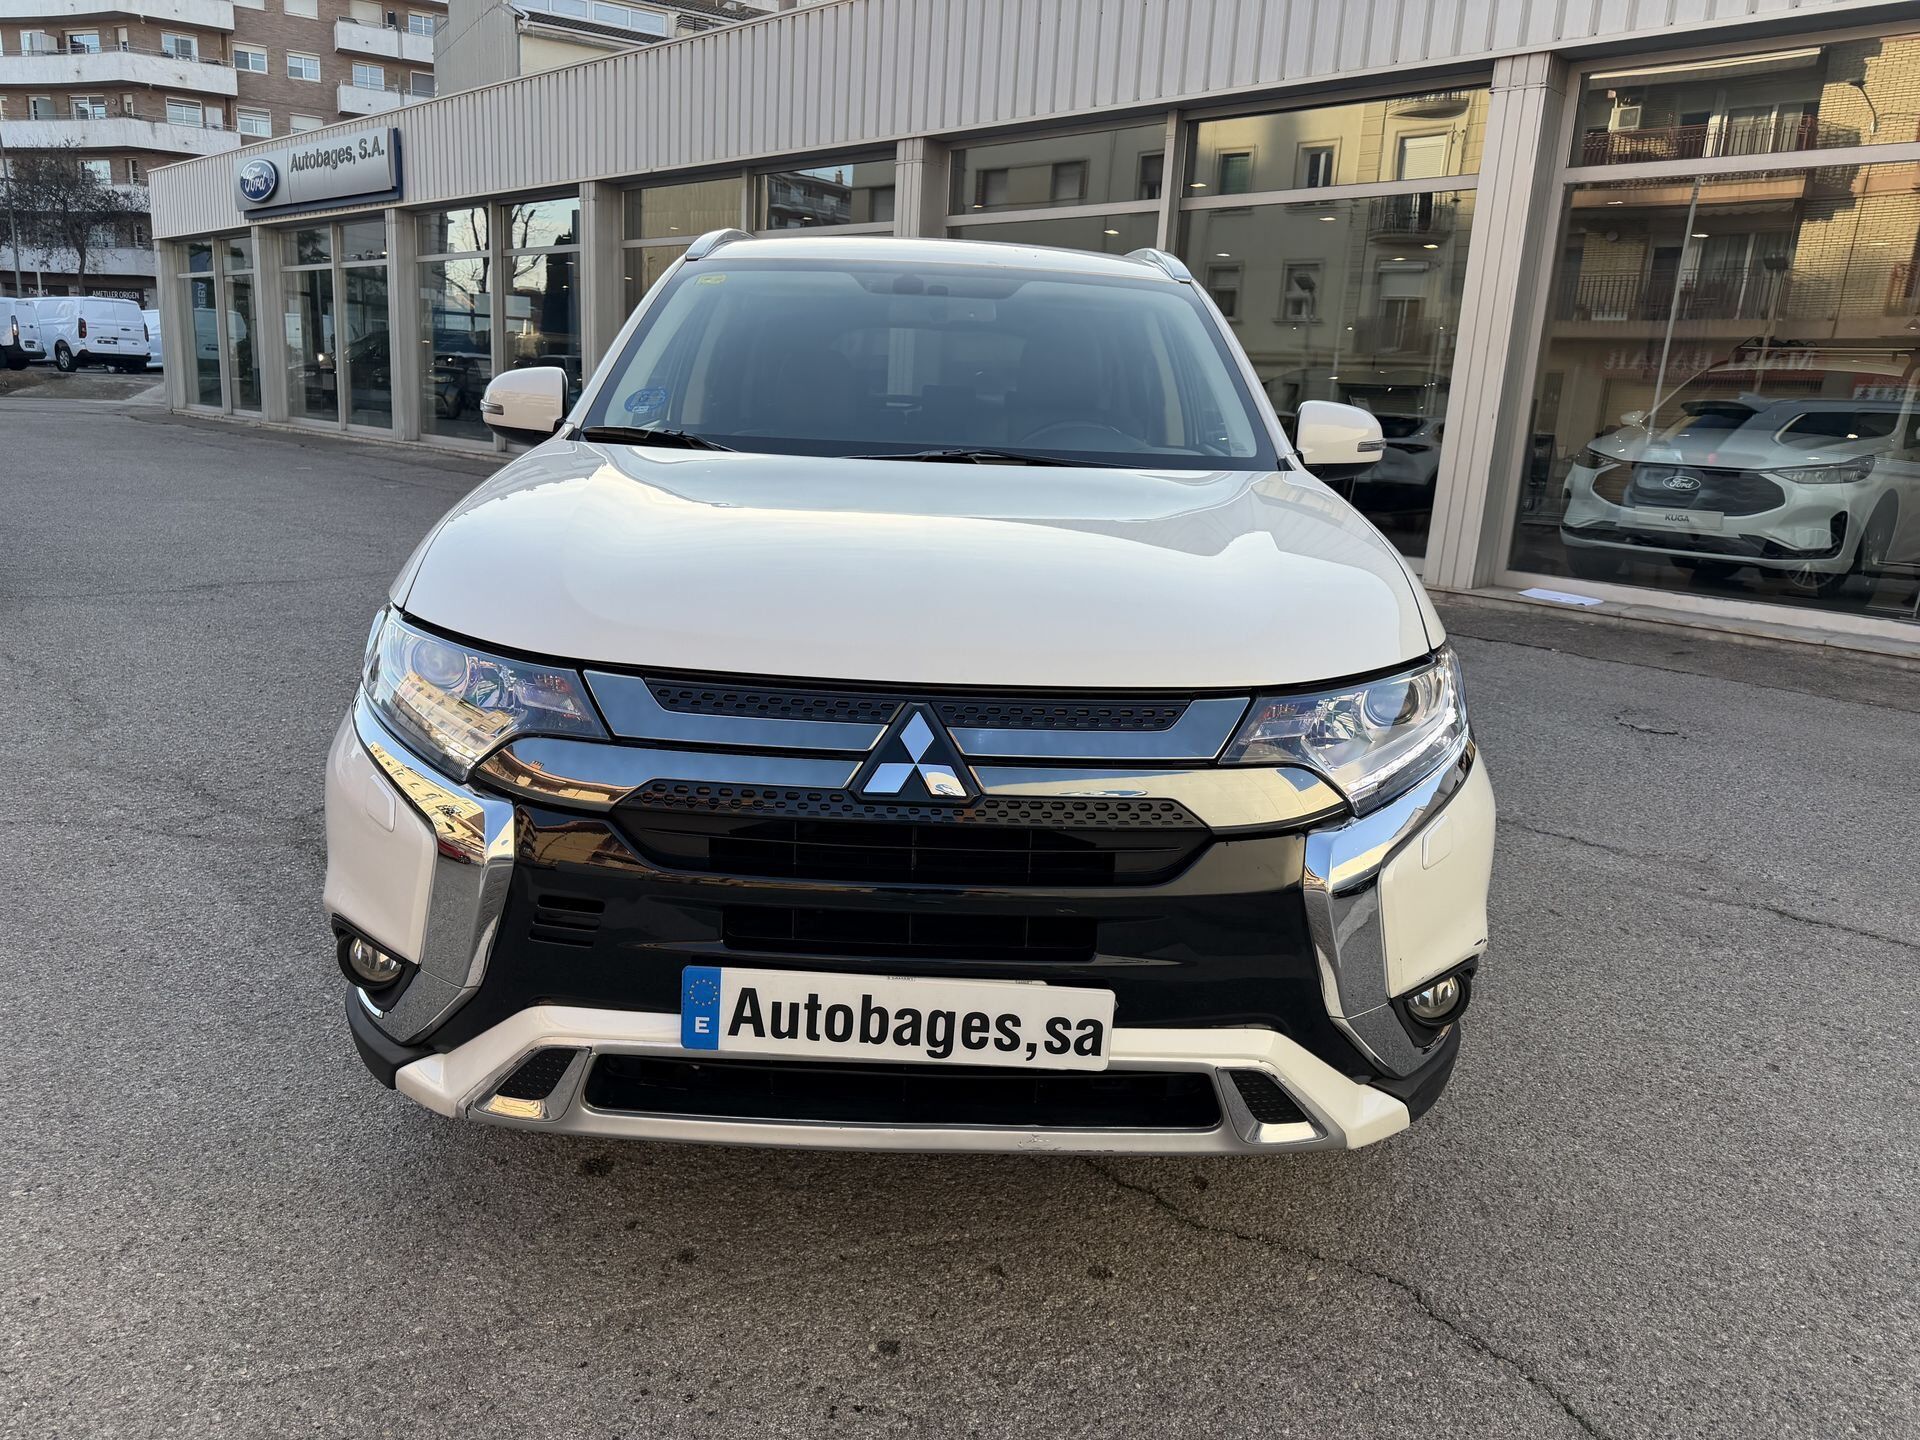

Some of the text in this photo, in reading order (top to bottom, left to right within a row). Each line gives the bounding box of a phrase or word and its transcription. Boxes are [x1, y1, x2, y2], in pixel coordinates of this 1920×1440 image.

[290, 136, 385, 173] Autobages, S.A.
[244, 166, 267, 193] Ford
[119, 291, 139, 299] ORIGEN
[1669, 478, 1694, 489] Ford
[1664, 513, 1690, 523] KUGA
[694, 1016, 710, 1034] E
[728, 987, 1105, 1062] Autobages,sa
